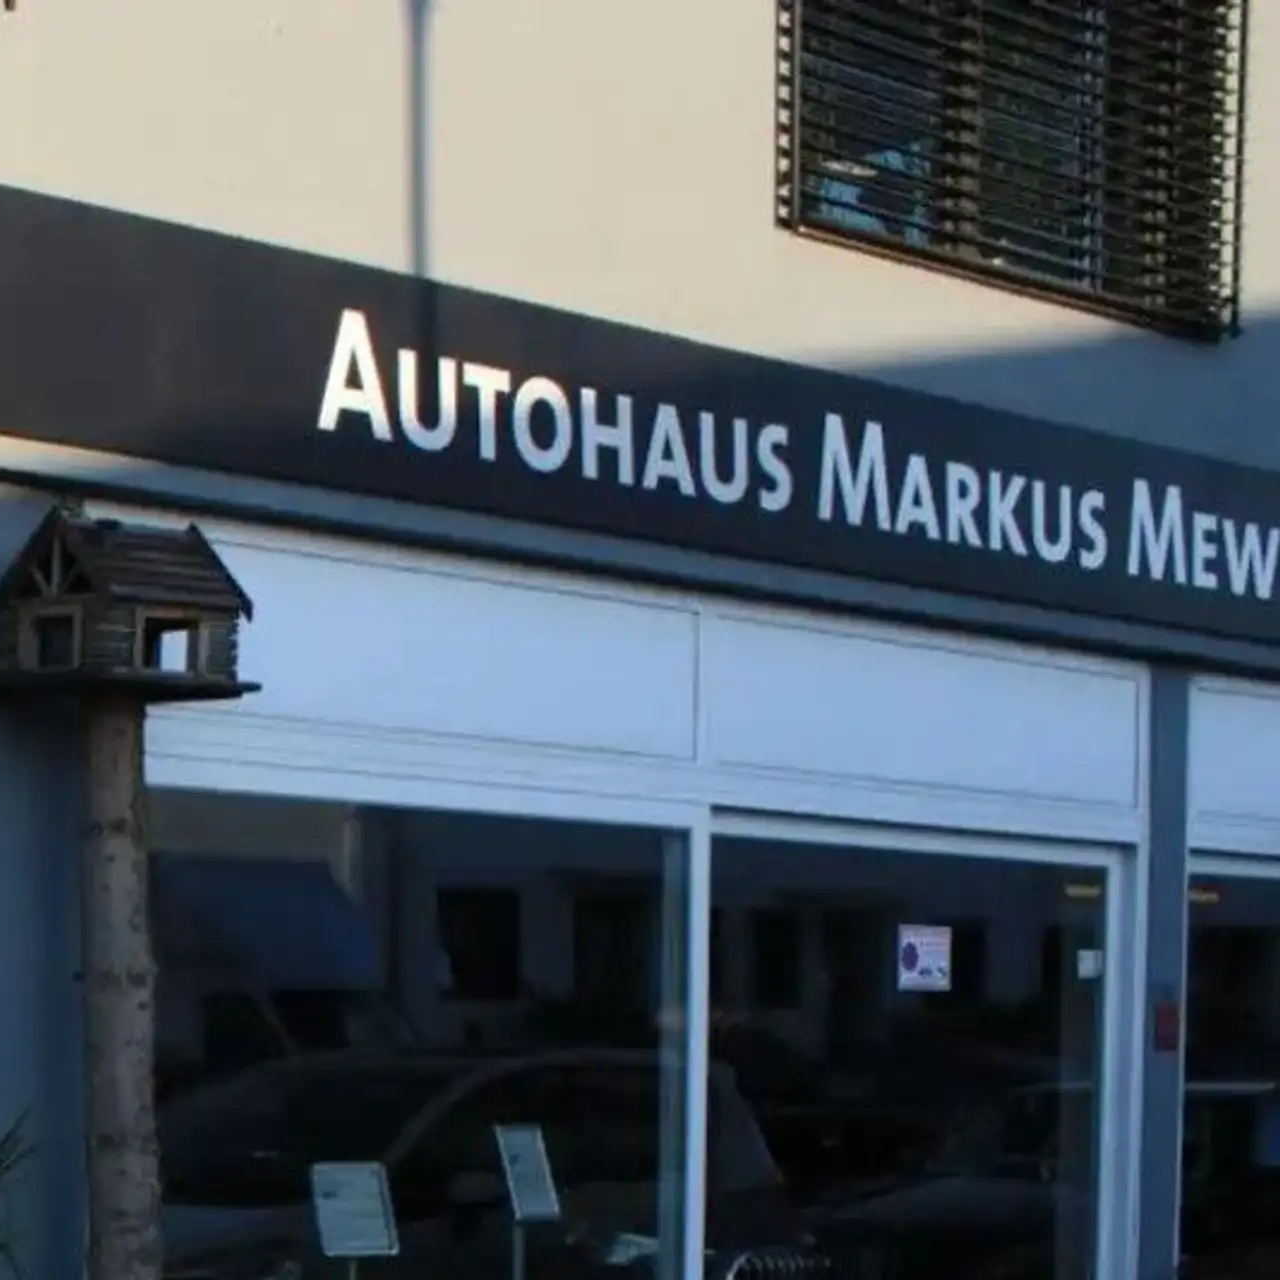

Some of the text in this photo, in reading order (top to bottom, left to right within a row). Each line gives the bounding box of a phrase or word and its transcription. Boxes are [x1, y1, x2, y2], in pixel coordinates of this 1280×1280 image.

[316, 306, 1280, 600] AUTOHAUS MARKUS MEW
